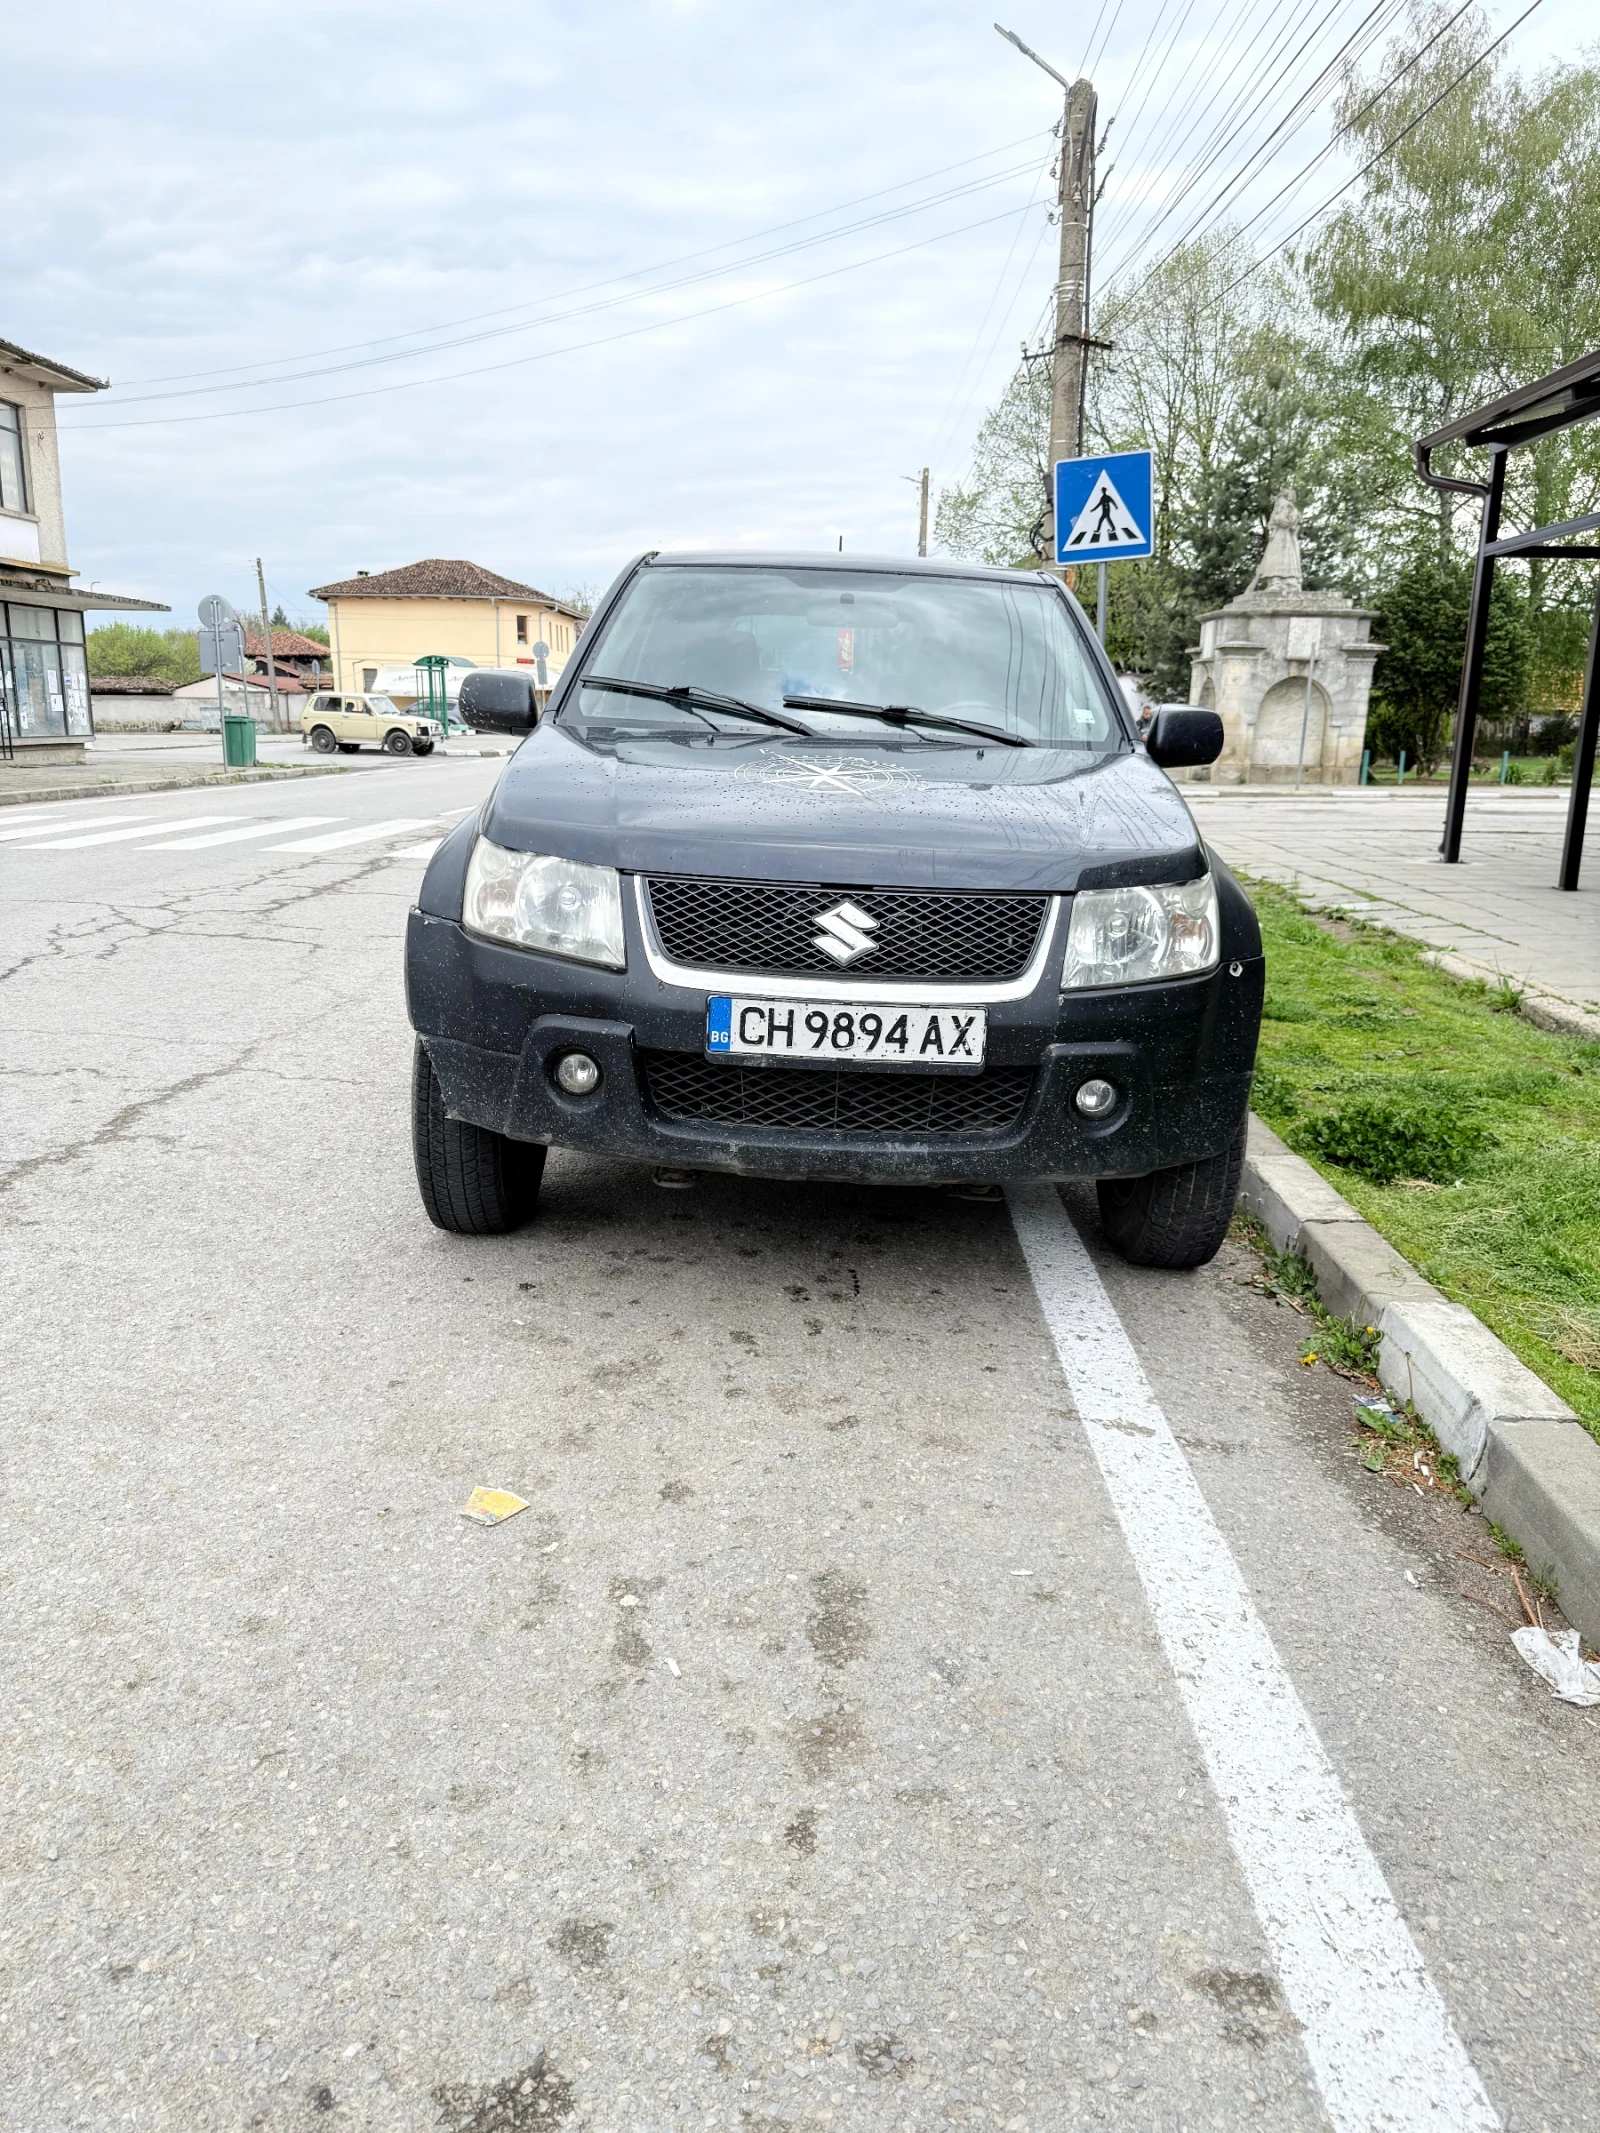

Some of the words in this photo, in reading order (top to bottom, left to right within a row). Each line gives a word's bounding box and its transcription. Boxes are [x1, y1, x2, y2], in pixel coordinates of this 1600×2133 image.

[710, 1031, 729, 1043] BG
[740, 1006, 794, 1048] CH
[805, 1010, 908, 1053] 9894
[919, 1015, 976, 1056] AX
